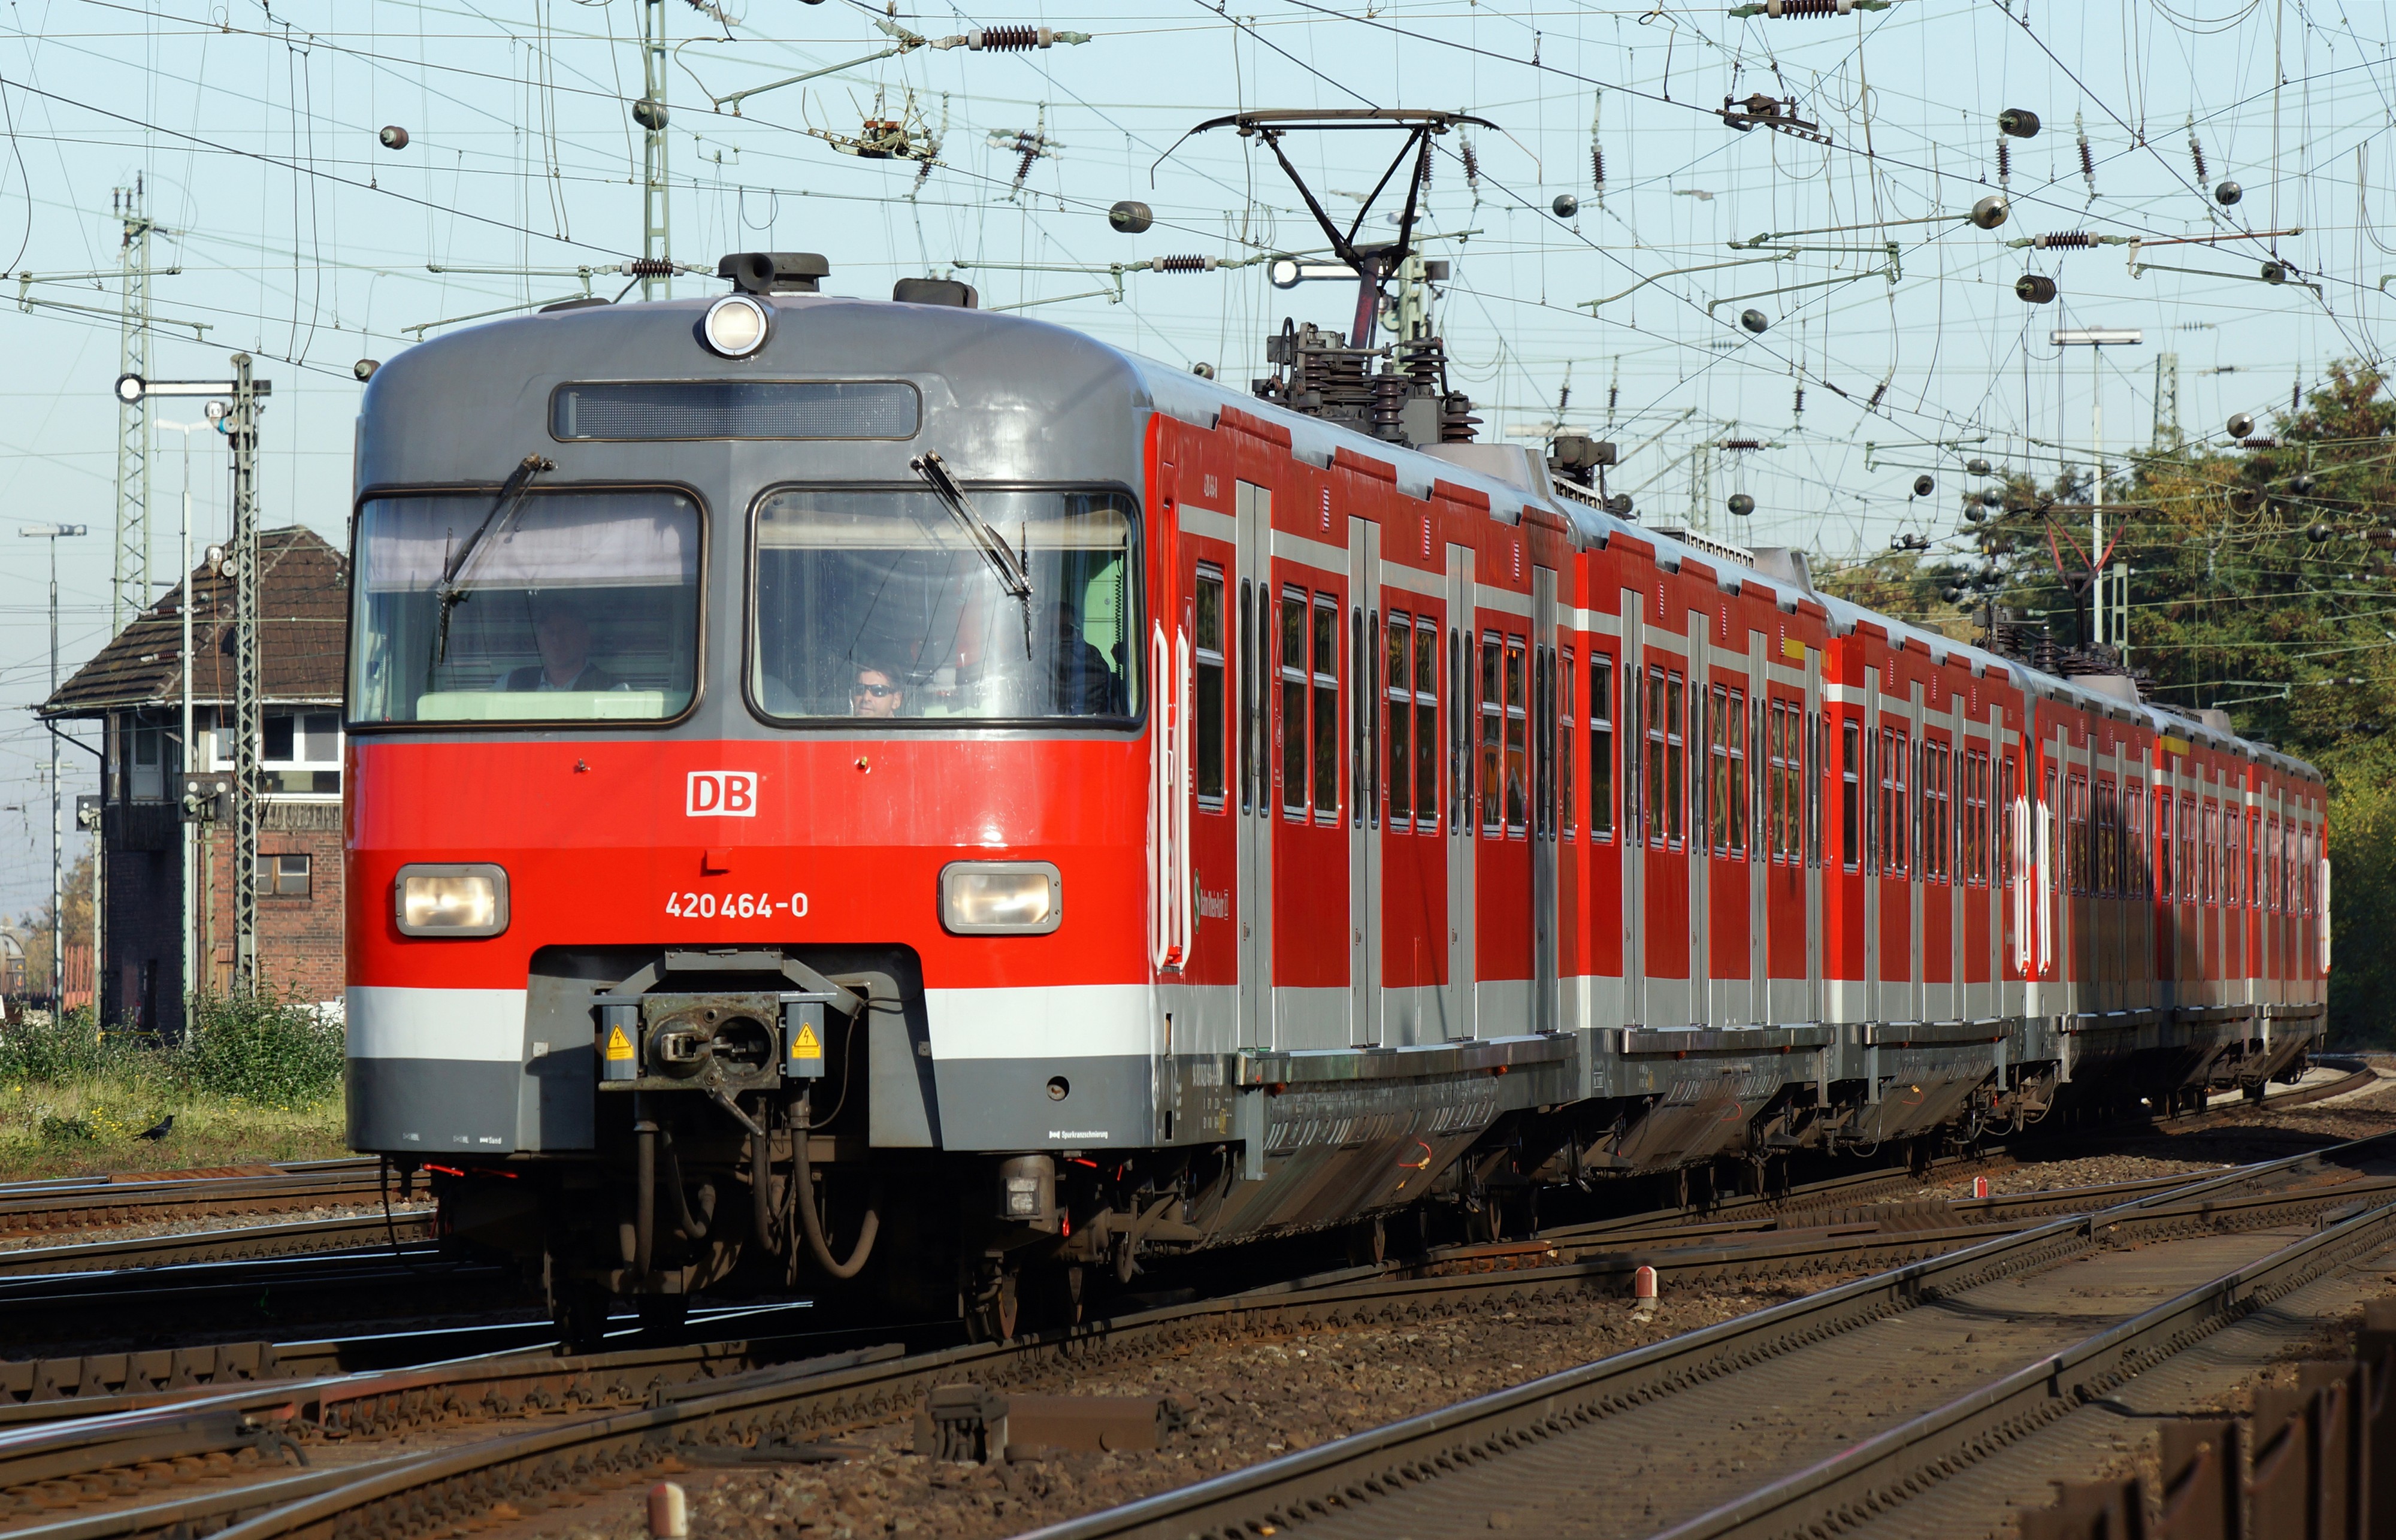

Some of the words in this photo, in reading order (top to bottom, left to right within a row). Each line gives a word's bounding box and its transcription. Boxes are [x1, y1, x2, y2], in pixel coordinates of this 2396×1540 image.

[1275, 607, 1281, 677] 2
[1382, 632, 1388, 698] 2
[691, 774, 752, 812] DB
[665, 891, 716, 918] 420
[720, 892, 809, 919] 464-0
[488, 1136, 502, 1145] Sand
[1061, 1130, 1109, 1140] Spurkranzschmierung
